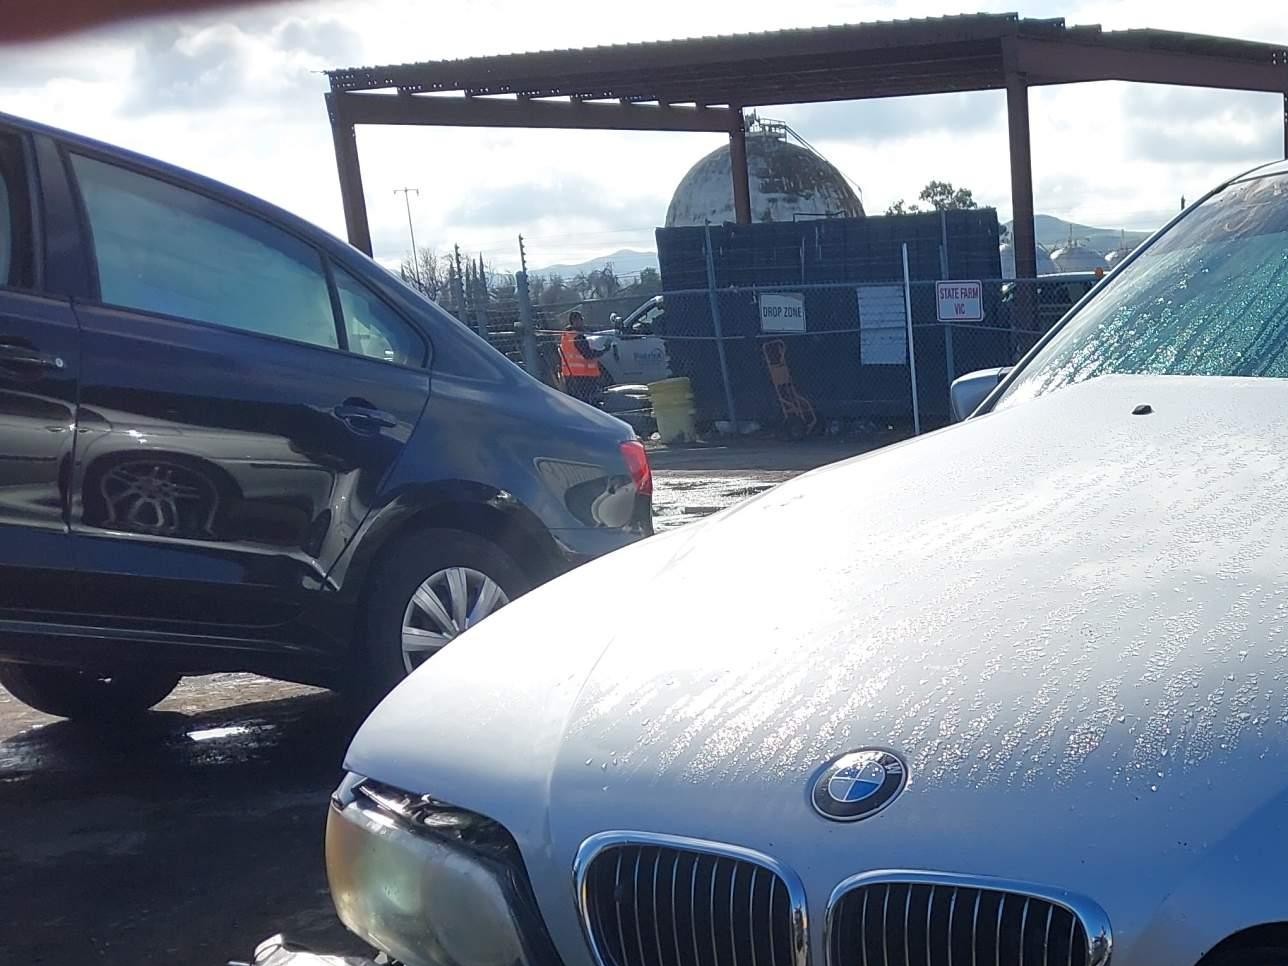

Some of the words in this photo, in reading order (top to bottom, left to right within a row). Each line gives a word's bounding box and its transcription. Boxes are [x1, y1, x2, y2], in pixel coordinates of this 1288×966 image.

[939, 287, 960, 300] STATE
[960, 287, 979, 299] FARM
[762, 306, 783, 318] DROP
[783, 306, 802, 318] ZONE
[954, 303, 966, 315] VIC
